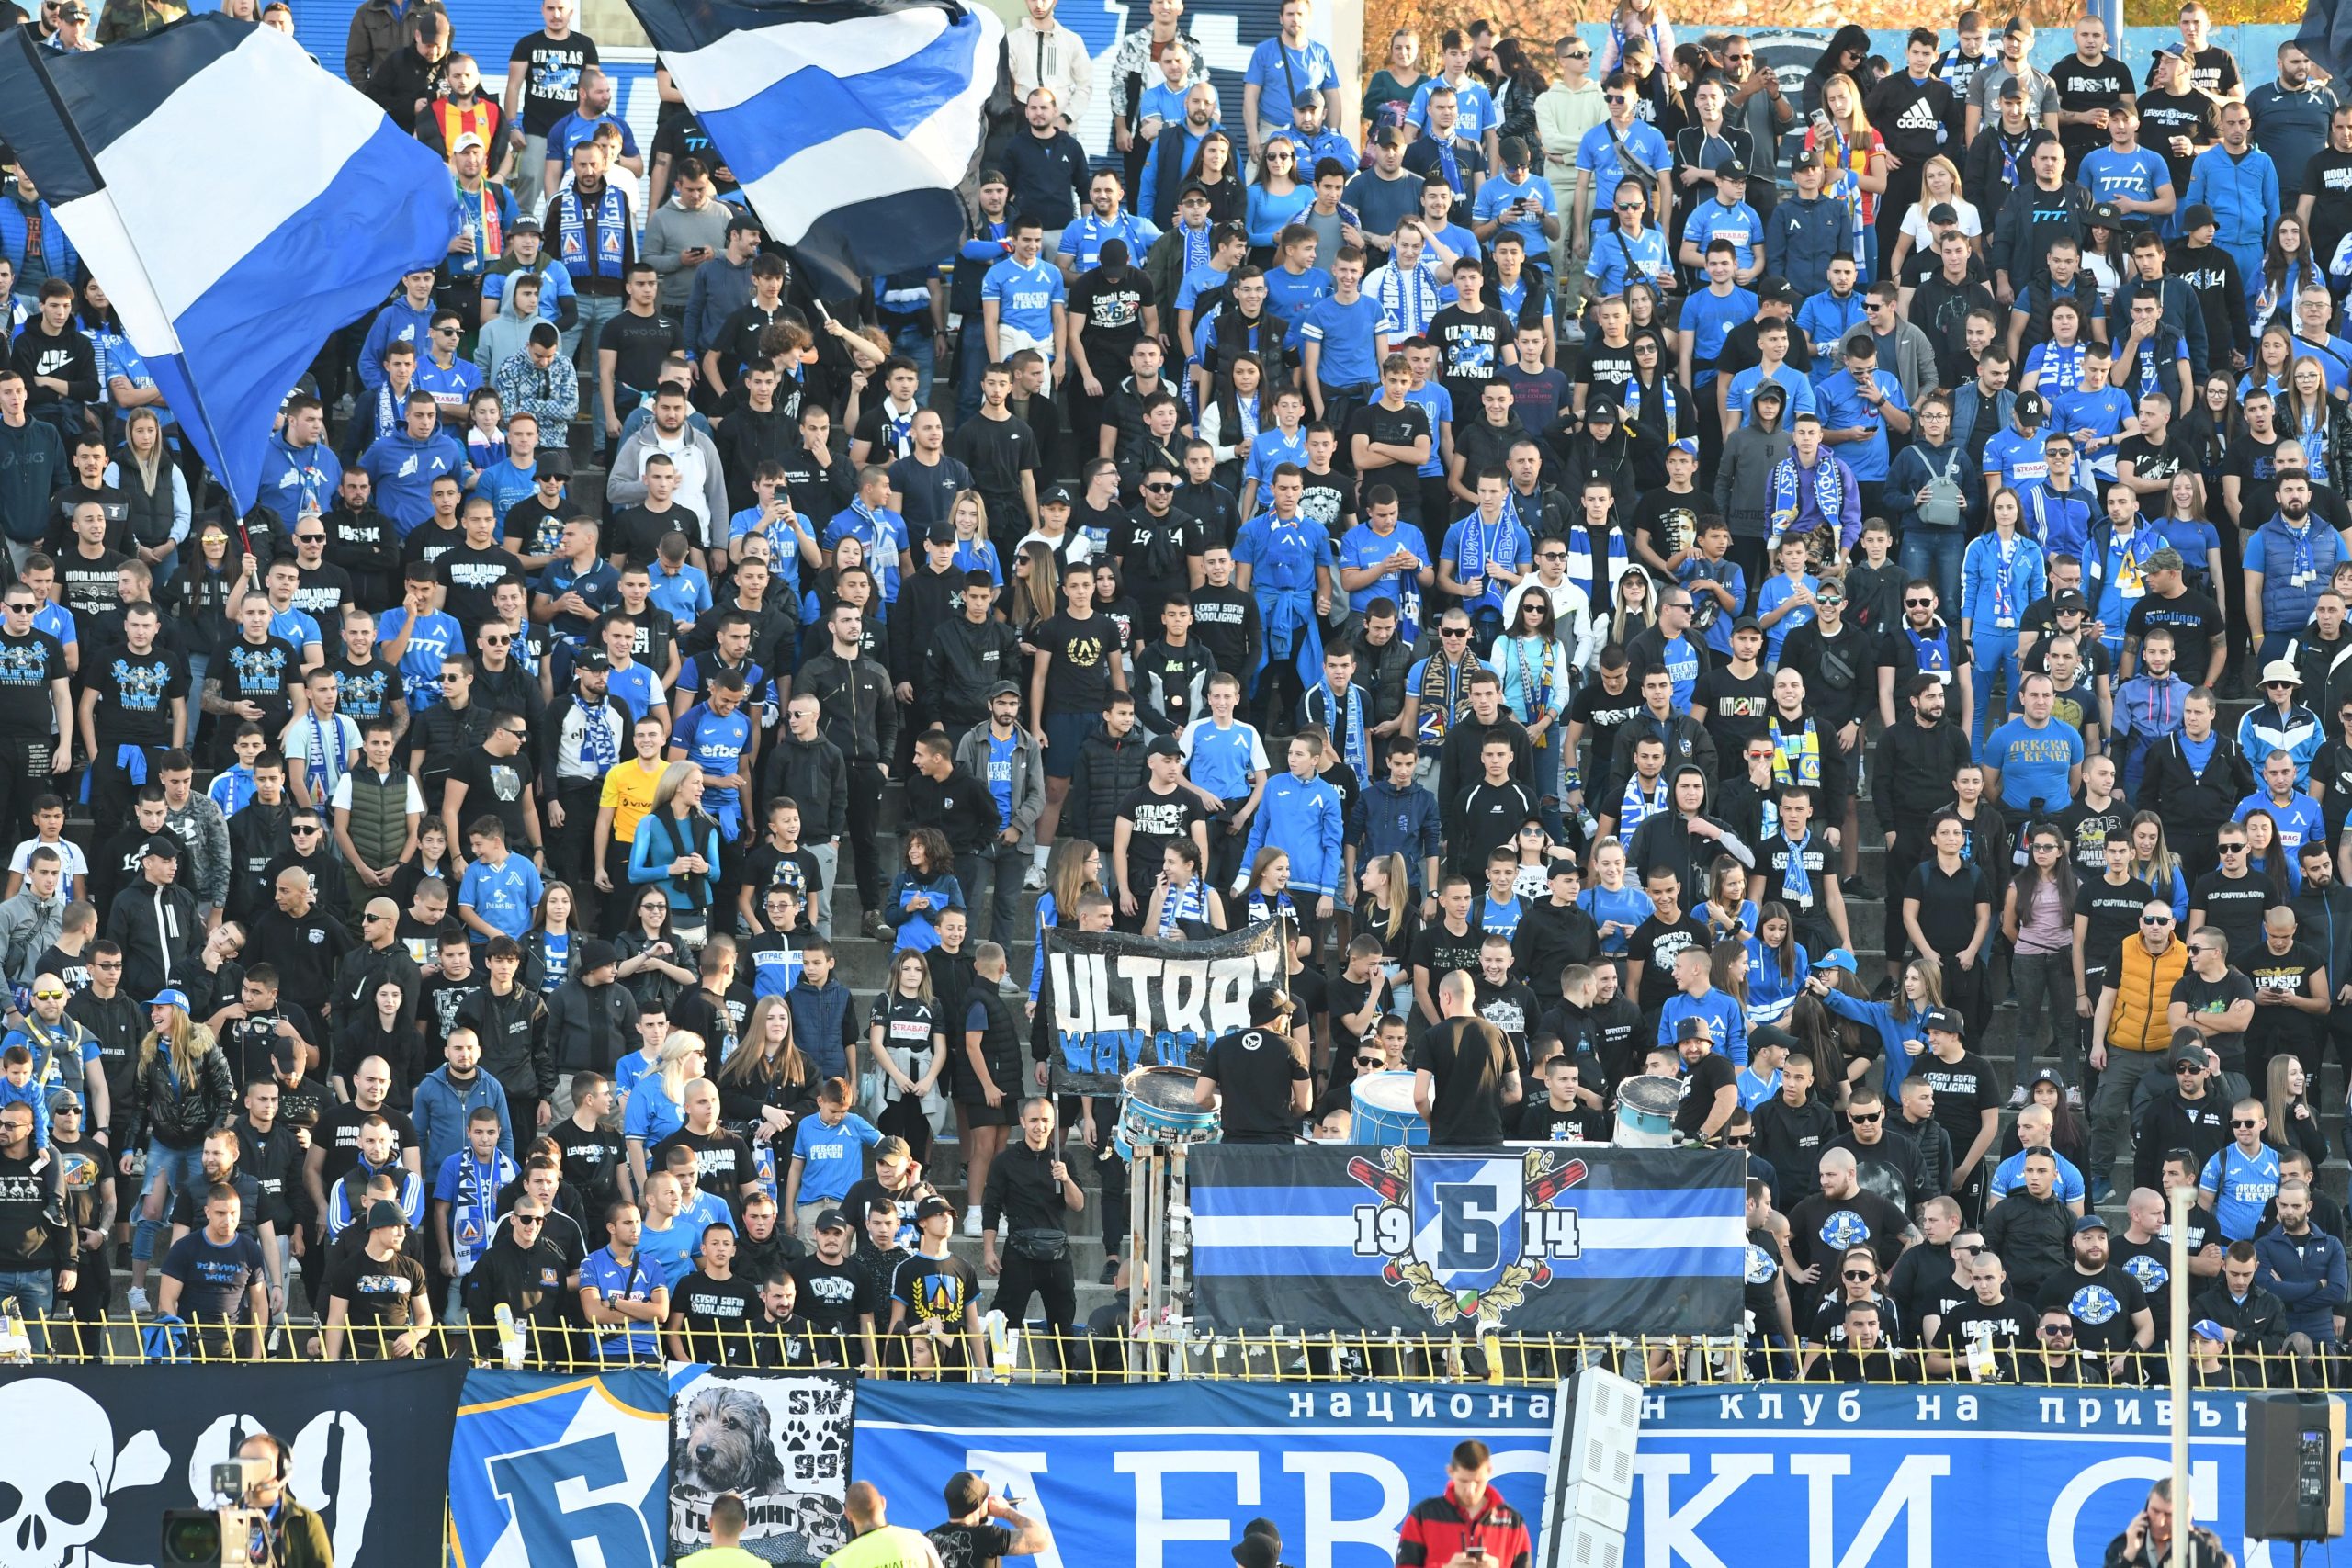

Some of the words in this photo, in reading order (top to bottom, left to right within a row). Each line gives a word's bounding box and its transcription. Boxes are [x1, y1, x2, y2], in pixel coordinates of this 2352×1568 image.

[532, 49, 584, 66] ULTRAS
[531, 84, 579, 102] LEVSKI
[1897, 116, 1939, 130] adidas
[2324, 168, 2352, 181] HOOLI
[1713, 231, 1748, 241] STRABAG
[1092, 293, 1118, 306] Levski
[1119, 290, 1141, 303] Sofia
[622, 328, 672, 340] SWOOSH
[1445, 323, 1496, 341] ULTRAS
[1446, 365, 1495, 378] LEVSKI
[1591, 359, 1632, 372] HOOLIGA
[432, 395, 460, 403] TRABAG
[1132, 528, 1153, 546] 19
[66, 571, 119, 582] HOOLIGANS
[290, 587, 341, 602] OOLIGANS
[1194, 603, 1220, 613] LEVSKI
[1222, 604, 1245, 615] SOFIA
[1165, 660, 1183, 672] ike
[2279, 833, 2299, 842] ABAG
[249, 857, 272, 865] HOOLI
[1802, 852, 1824, 862] SOFIA
[2220, 891, 2249, 900] CAPITAL
[2103, 899, 2129, 908] CAPITAL
[1652, 931, 1694, 949] OMERTA
[2256, 975, 2301, 989] LEVSKI
[1050, 950, 1280, 1040] ULTRA
[891, 1022, 930, 1033] STRABAG
[1059, 1029, 1146, 1075] WAY
[1154, 1030, 1198, 1068] OF
[1923, 1073, 1951, 1084] LEVSKI
[1952, 1074, 1976, 1084] SOFIA
[1929, 1082, 1976, 1094] OOLIGANS
[695, 1148, 736, 1163] OLIGANS
[1356, 1207, 1412, 1255] 19
[1434, 1182, 1500, 1271] Б
[1523, 1210, 1579, 1258] 14
[690, 1294, 718, 1305] LEVSKI
[720, 1296, 745, 1307] SOFIA
[788, 1389, 842, 1416] SW
[1288, 1390, 1666, 1423] национан
[1719, 1388, 1862, 1427] клуб
[1916, 1393, 1979, 1422] на
[794, 1453, 838, 1480] 99
[684, 1504, 797, 1530] ГЬИНГ
